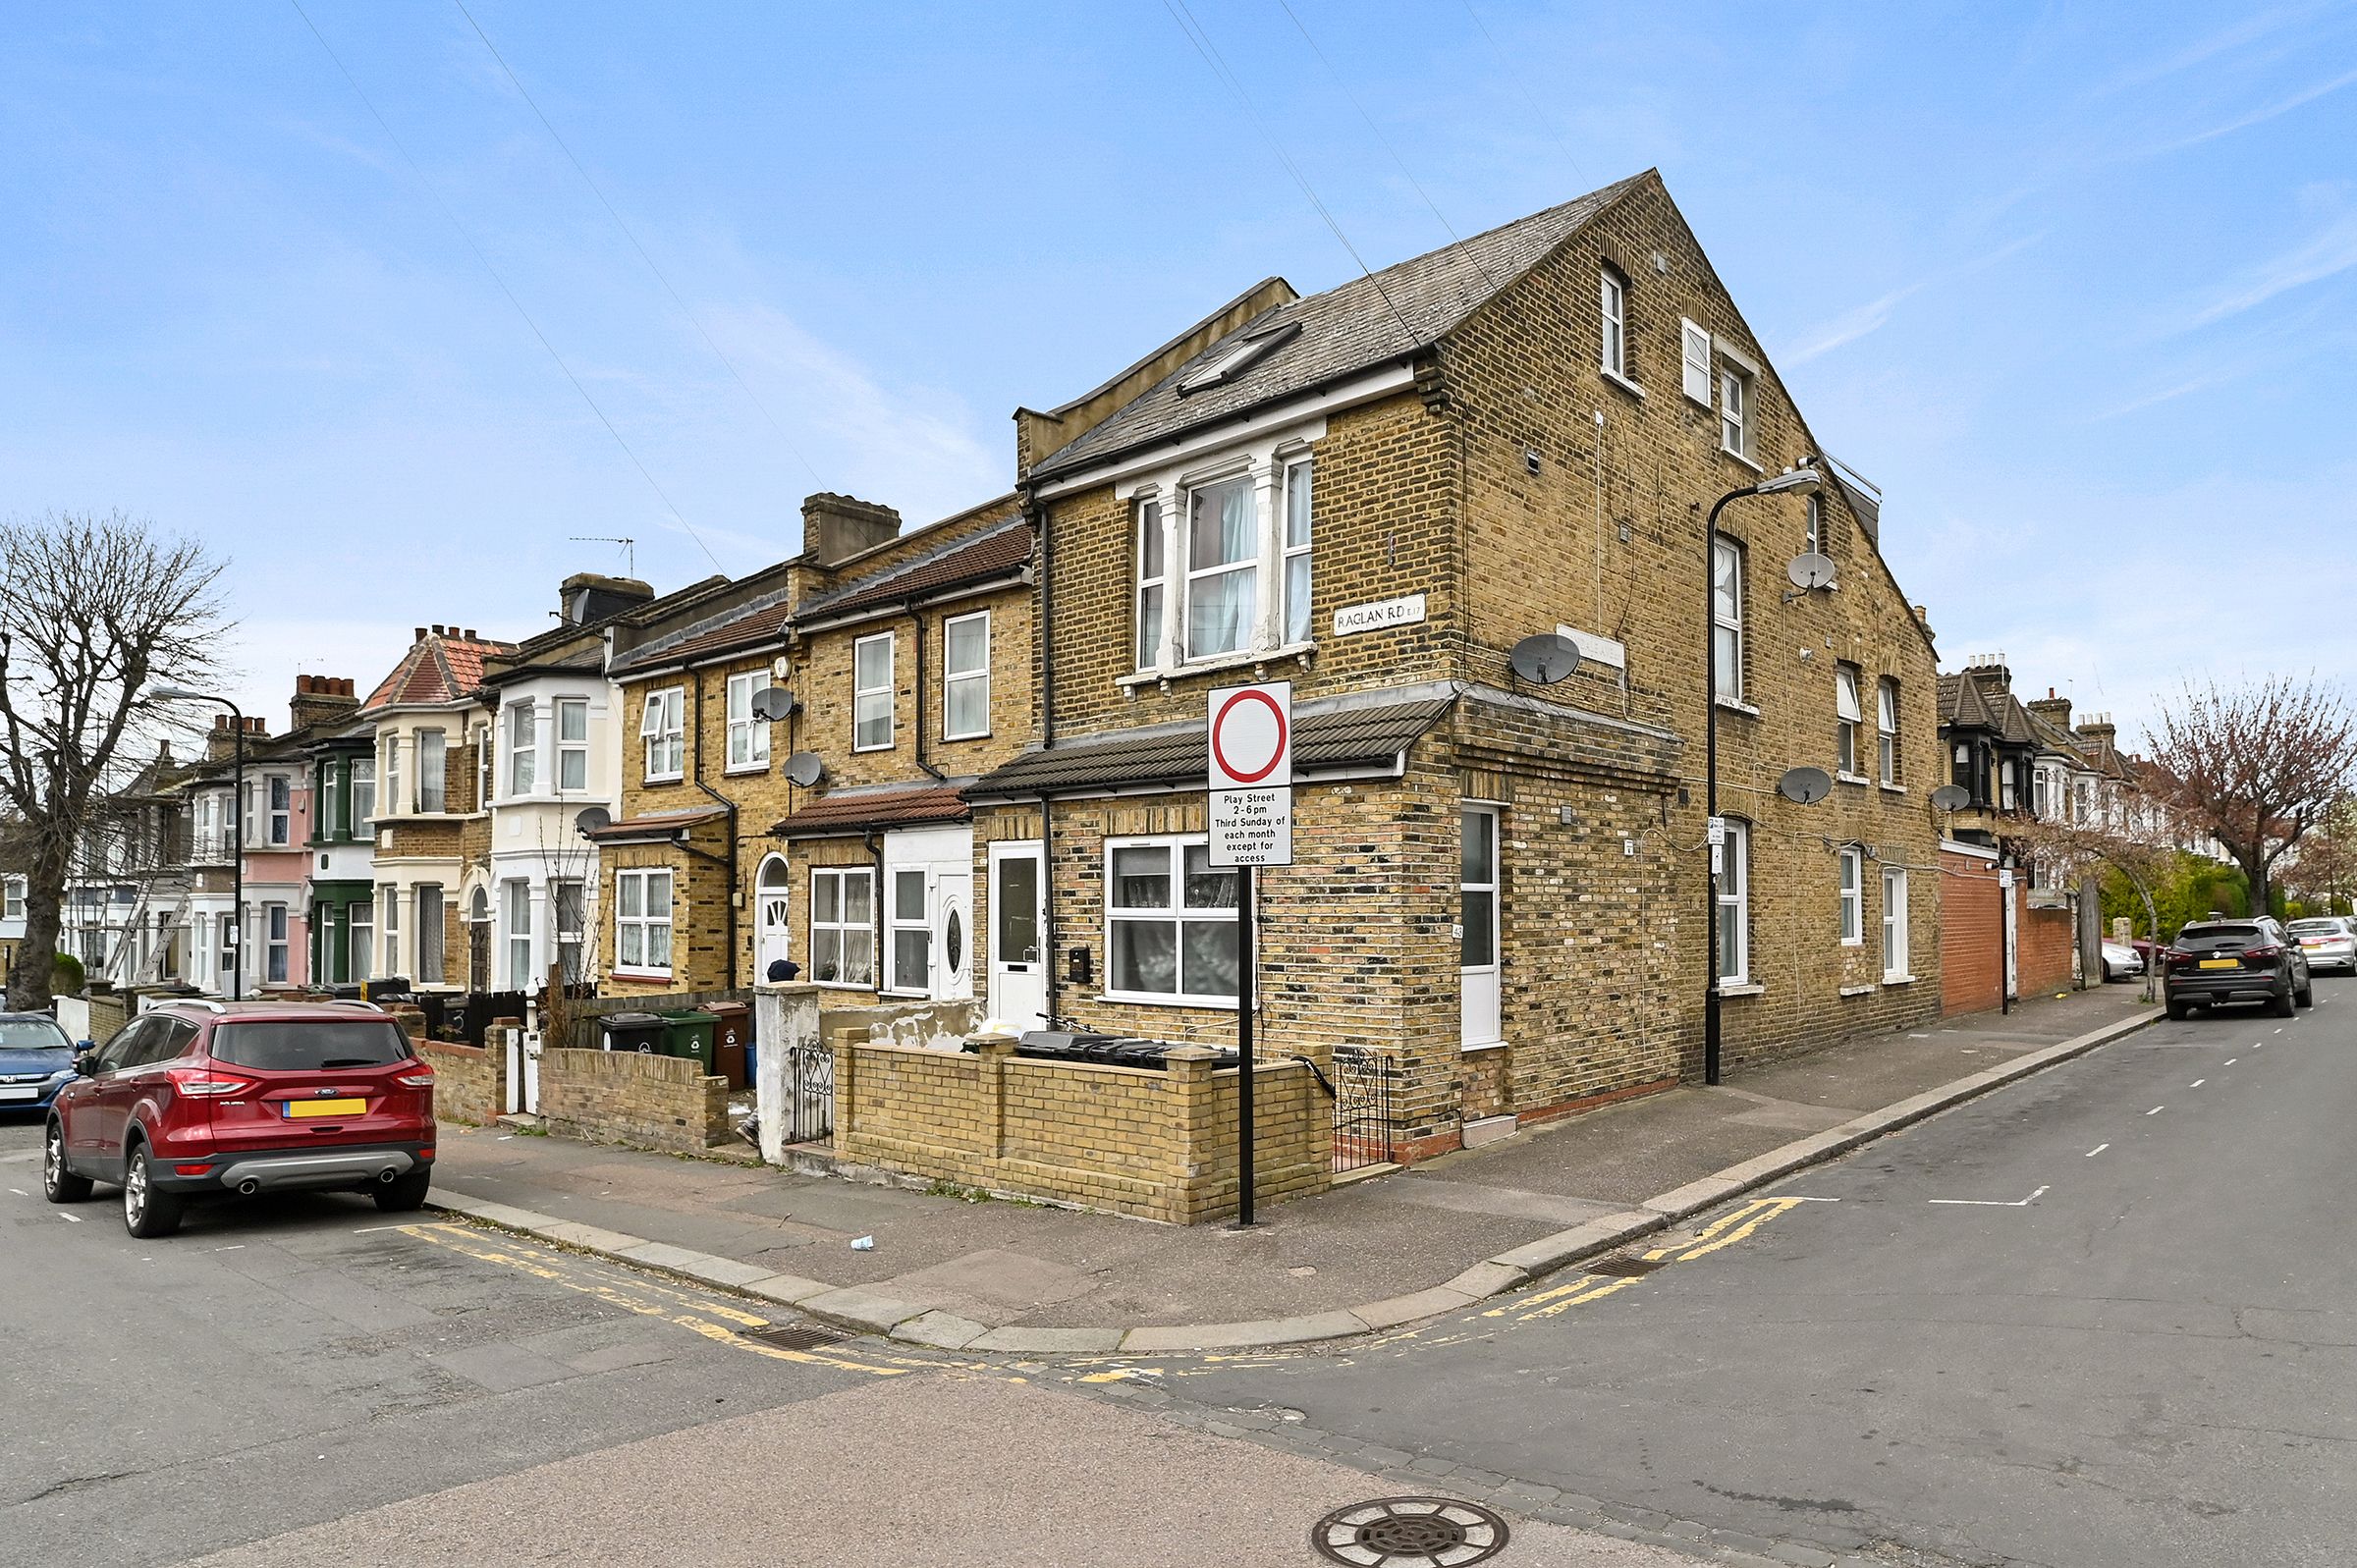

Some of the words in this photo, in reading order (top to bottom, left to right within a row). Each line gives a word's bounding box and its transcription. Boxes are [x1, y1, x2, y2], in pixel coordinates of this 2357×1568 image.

[1338, 608, 1383, 628] RAGLAN
[1388, 605, 1405, 620] RD
[1224, 794, 1243, 805] Play
[1246, 793, 1276, 803] Street
[1215, 818, 1237, 828] Third
[1239, 817, 1273, 828] Sunday
[1276, 815, 1286, 826] of
[1224, 830, 1245, 839] each
[1247, 829, 1276, 838] month
[1226, 841, 1257, 852] except
[1260, 840, 1274, 850] for
[1234, 854, 1266, 863] access
